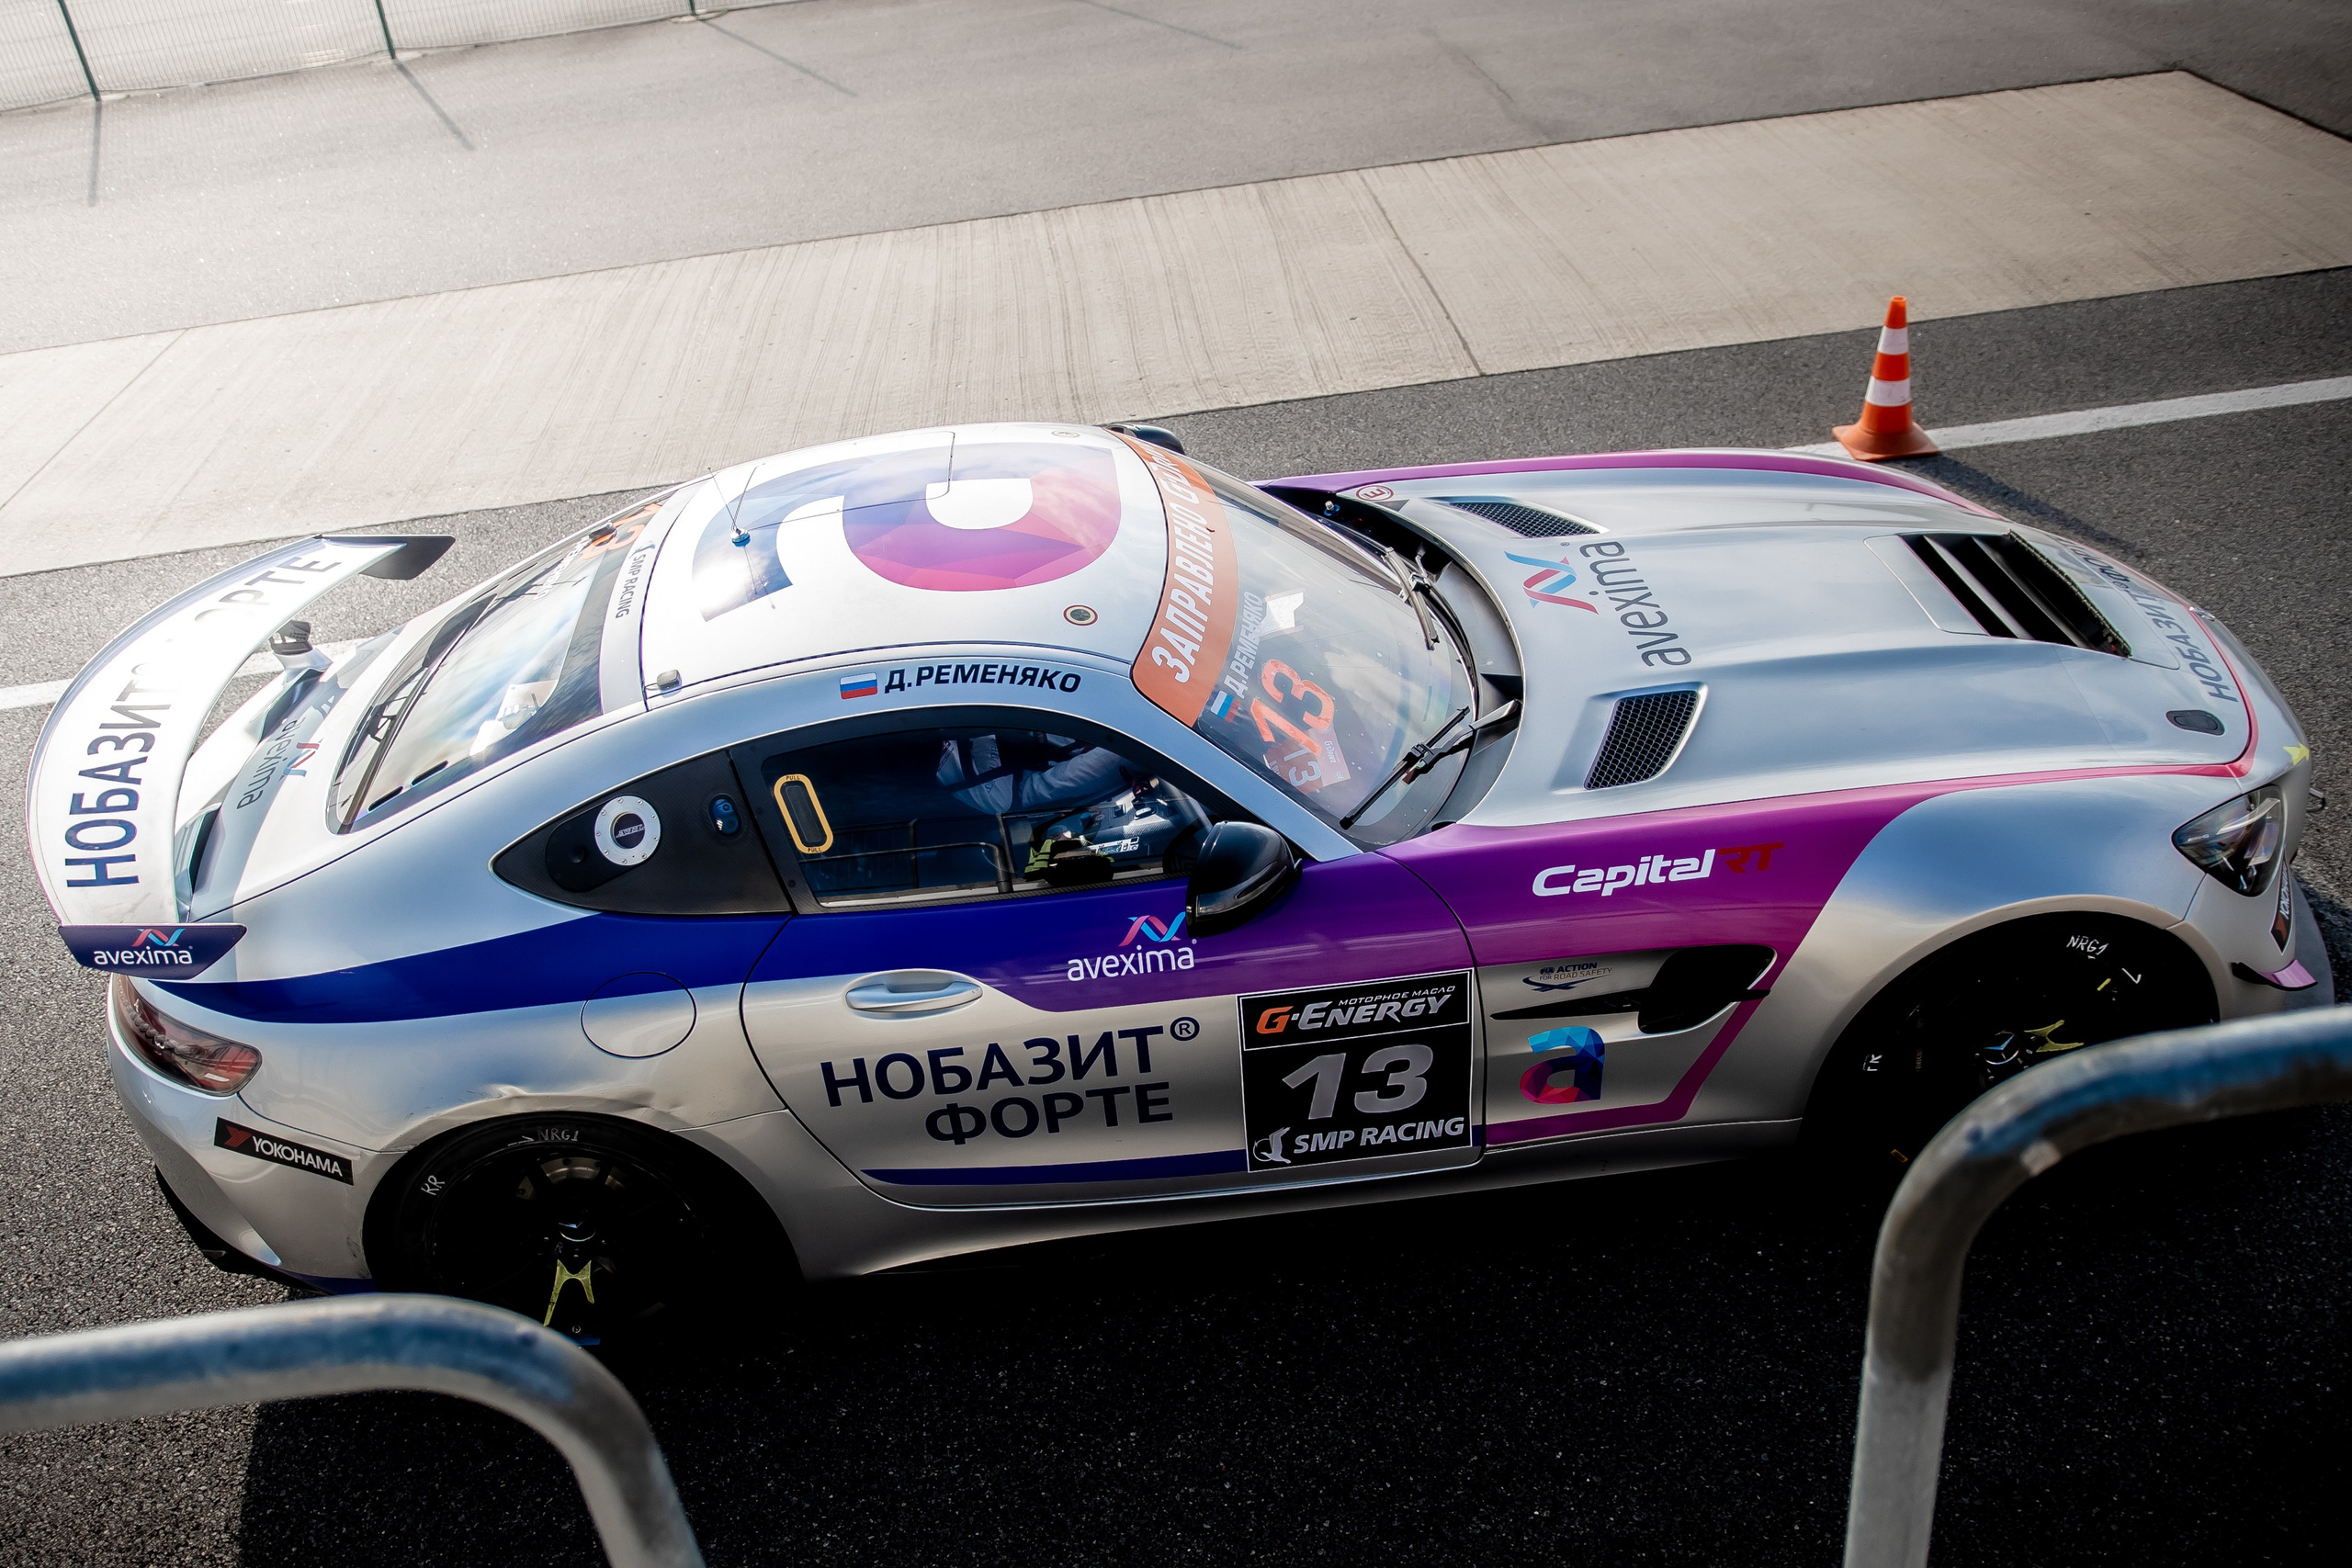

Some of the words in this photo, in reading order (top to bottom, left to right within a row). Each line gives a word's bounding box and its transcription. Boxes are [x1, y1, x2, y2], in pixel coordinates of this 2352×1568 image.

[628, 553, 647, 576] SMP
[615, 577, 639, 619] RACING
[1151, 502, 1215, 684] ЗАПРАВЛЕНО
[1578, 541, 1692, 667] avexima
[884, 663, 1081, 694] Д.РЕМЕНЯКО
[1250, 659, 1335, 756] 13
[64, 678, 172, 887] НОБАЗИТ
[236, 716, 307, 809] avexima
[94, 945, 193, 965] avexima
[1067, 944, 1194, 983] avexima
[1554, 972, 1578, 980] ROAD
[1579, 967, 1613, 977] SAFETY
[1556, 962, 1598, 974] ACTION
[1338, 991, 1410, 1007] МОТОРНОЕ
[1411, 985, 1456, 998] МАСЛО
[1282, 1043, 1433, 1121] 13
[924, 1081, 1174, 1146] ФОРТЕ
[252, 1135, 344, 1178] YOKOHAMA
[1293, 1129, 1355, 1154] SMP
[1360, 1117, 1465, 1146] RACING
